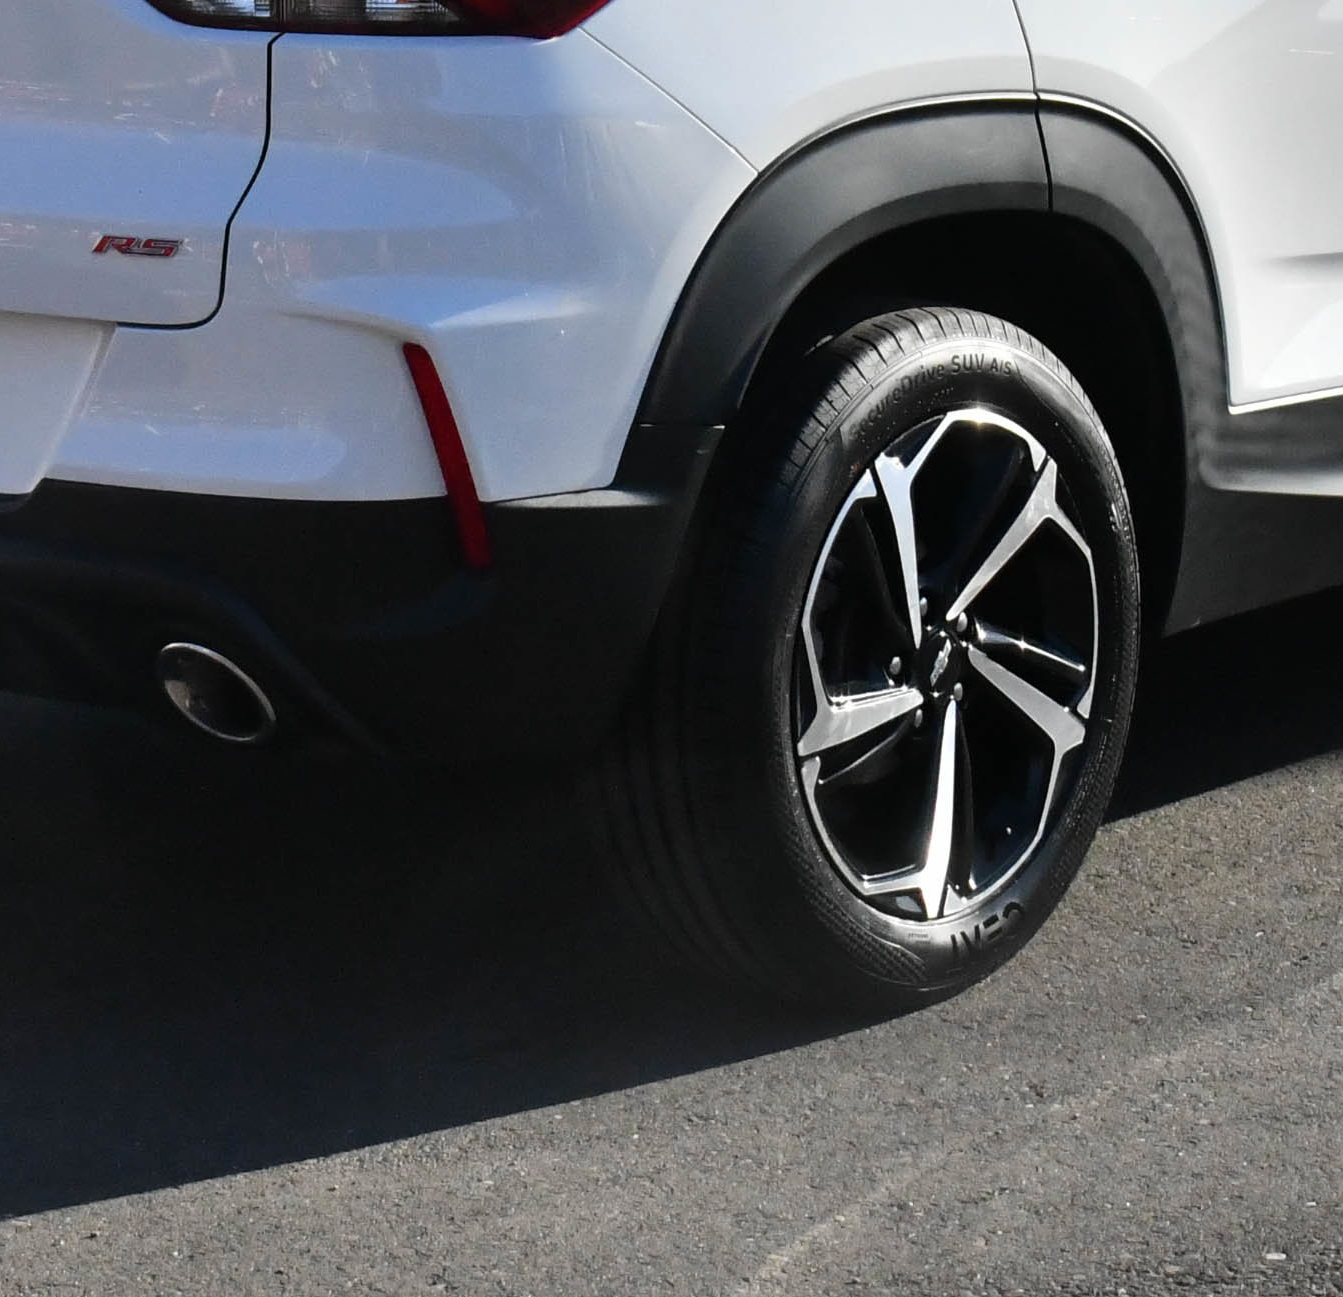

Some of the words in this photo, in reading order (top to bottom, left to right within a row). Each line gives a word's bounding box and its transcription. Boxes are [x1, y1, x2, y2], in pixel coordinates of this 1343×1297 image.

[92, 235, 183, 256] RS
[951, 353, 985, 375] SUV
[991, 357, 1012, 377] A/S
